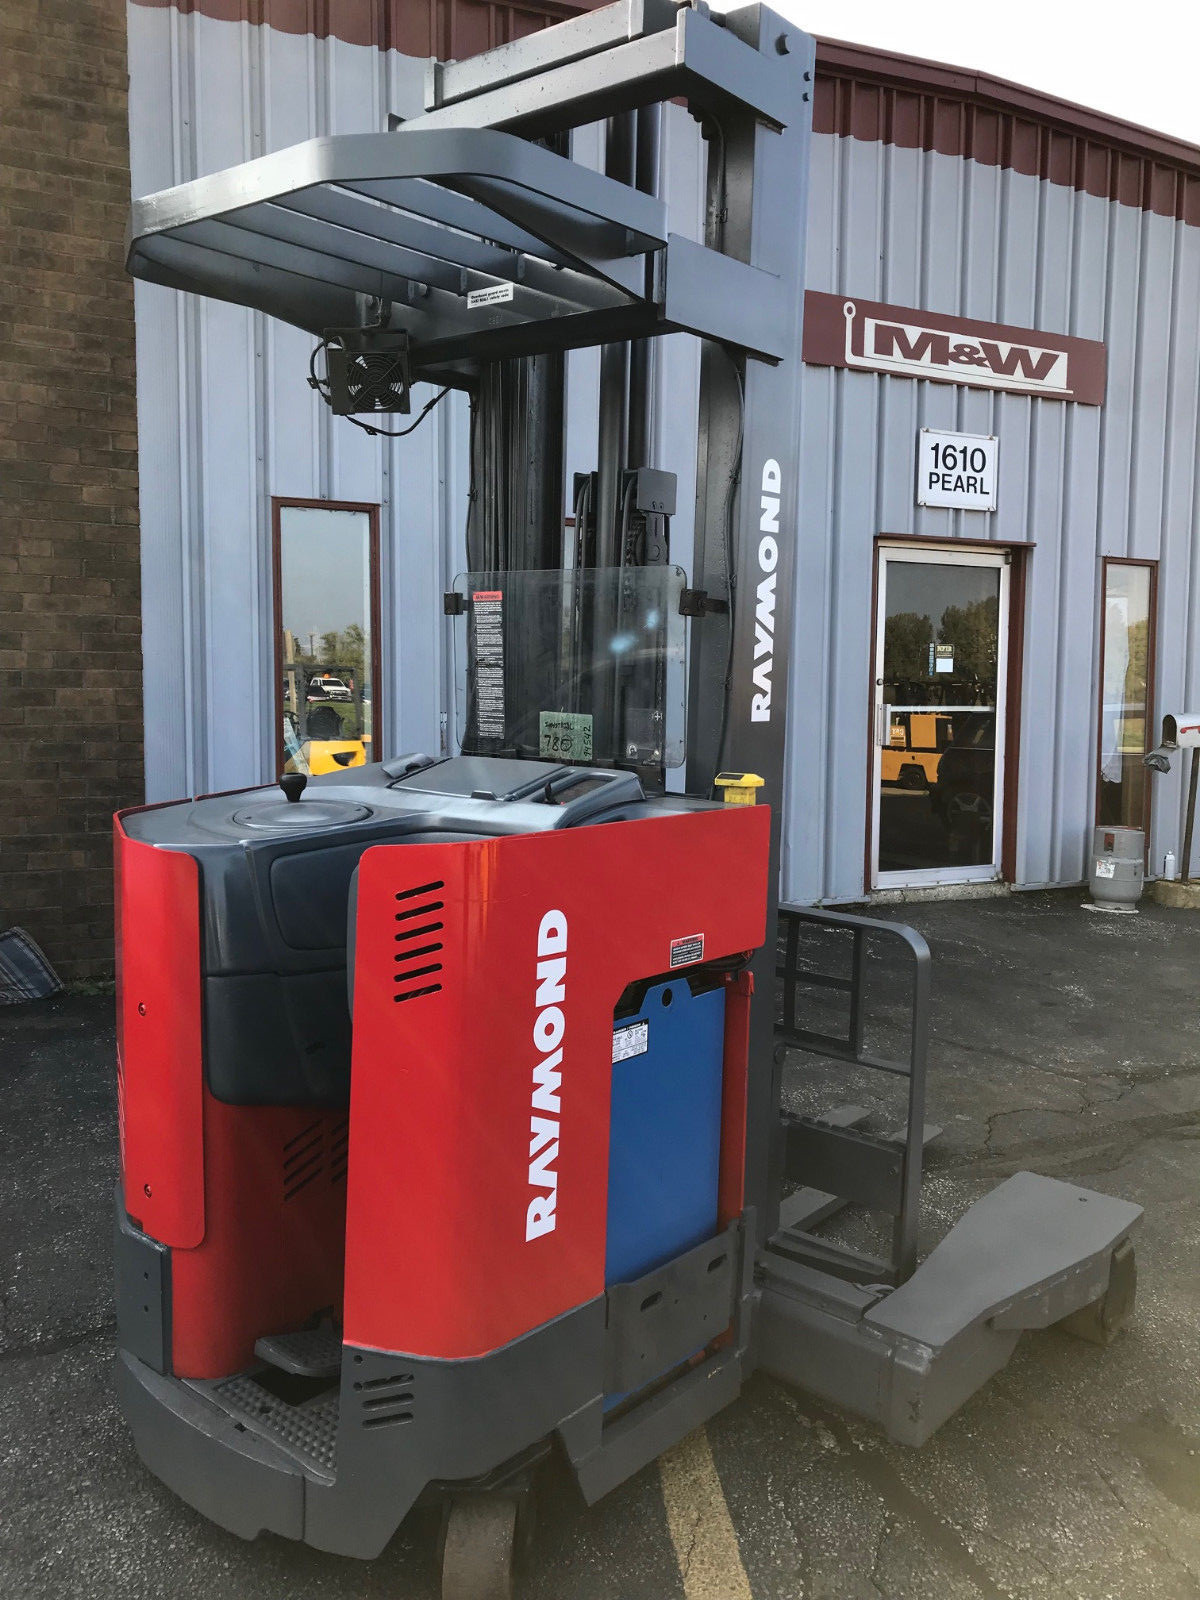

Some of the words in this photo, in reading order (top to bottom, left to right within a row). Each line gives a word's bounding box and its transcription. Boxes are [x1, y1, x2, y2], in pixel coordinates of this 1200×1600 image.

[874, 322, 1060, 381] M&W
[928, 472, 990, 495] PEARL
[930, 443, 986, 473] 1610
[751, 458, 781, 722] RAYMOND
[525, 909, 568, 1242] RAYMOND
